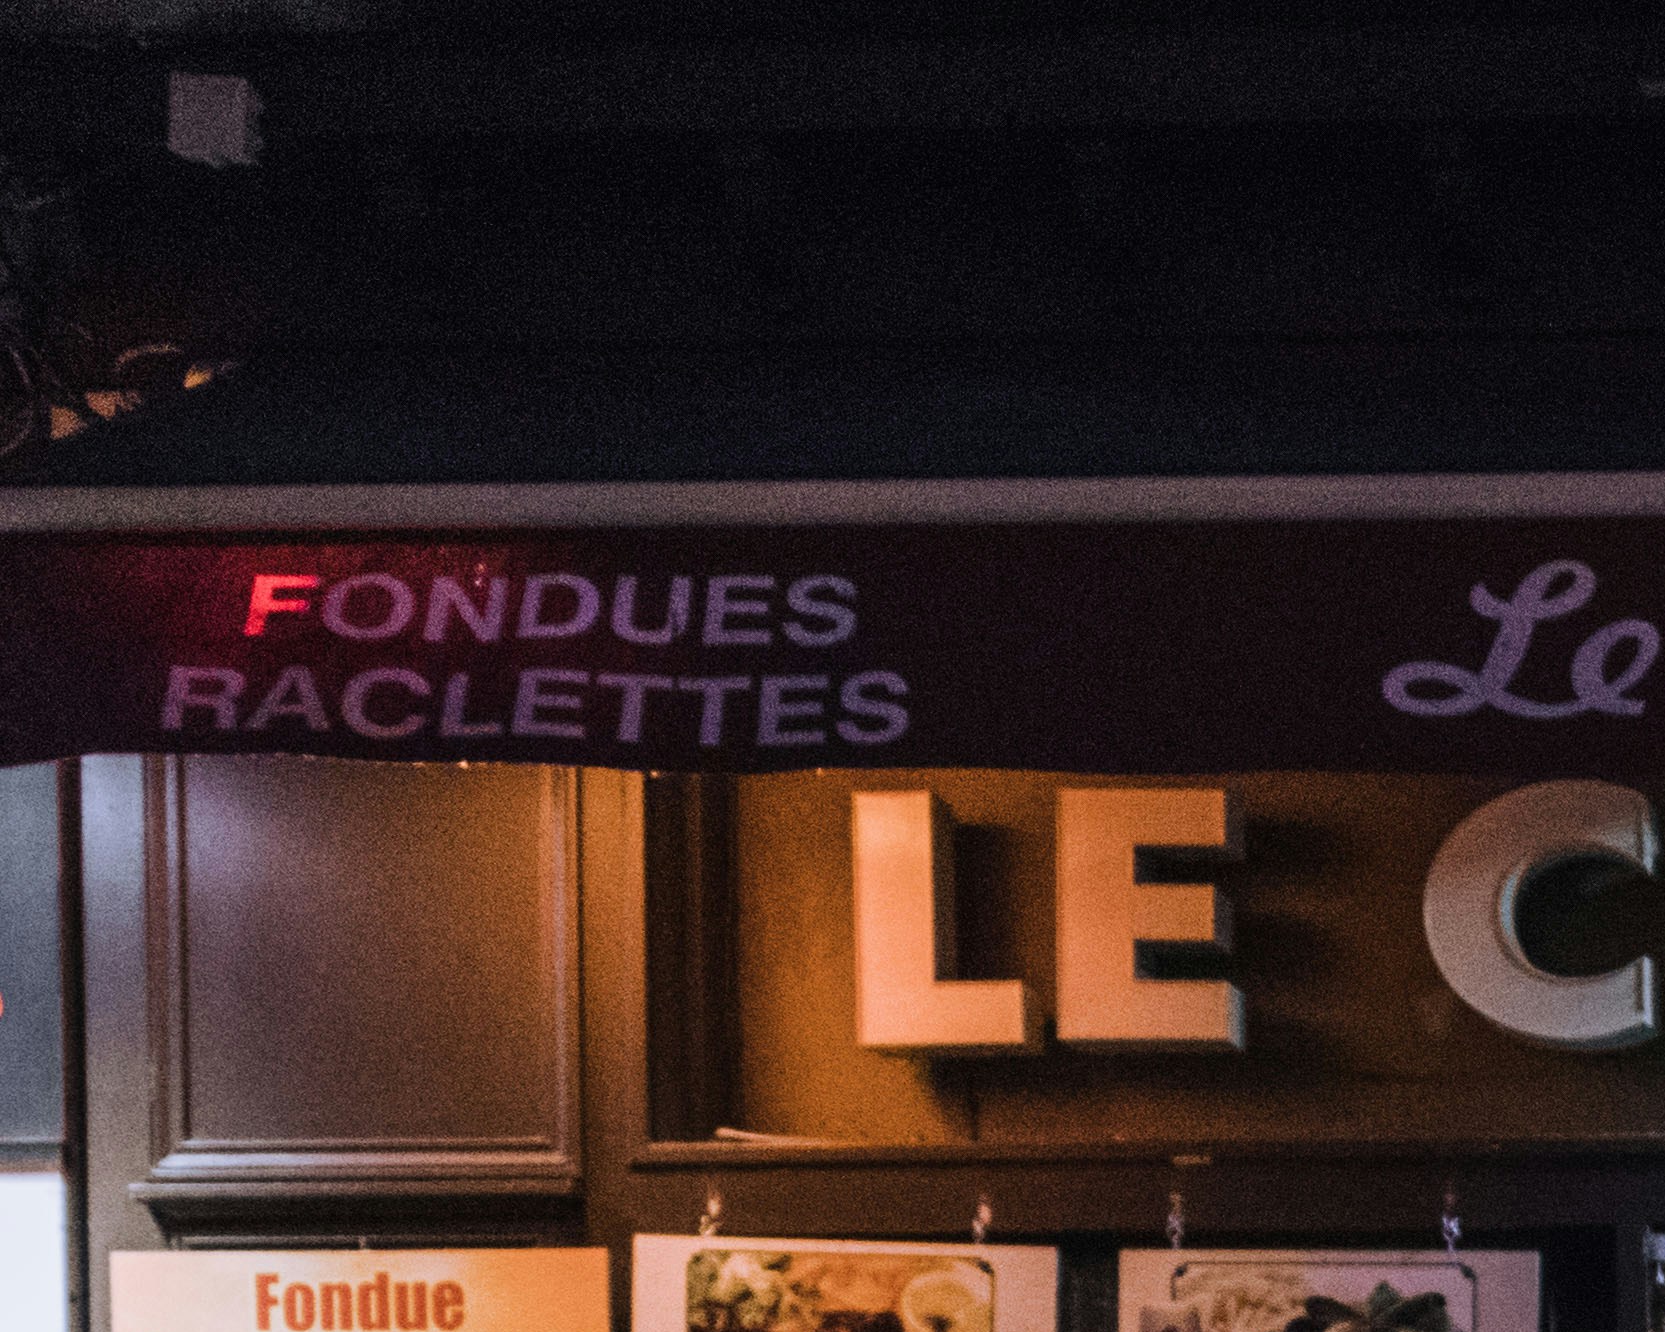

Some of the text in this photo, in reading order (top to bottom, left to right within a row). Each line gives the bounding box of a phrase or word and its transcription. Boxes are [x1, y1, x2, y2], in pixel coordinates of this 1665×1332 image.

[243, 572, 860, 648] FONDUES
[1381, 559, 1663, 719] Le
[158, 664, 912, 748] RACLETTES
[851, 787, 1242, 1051] LE
[254, 1272, 465, 1331] Fondue
